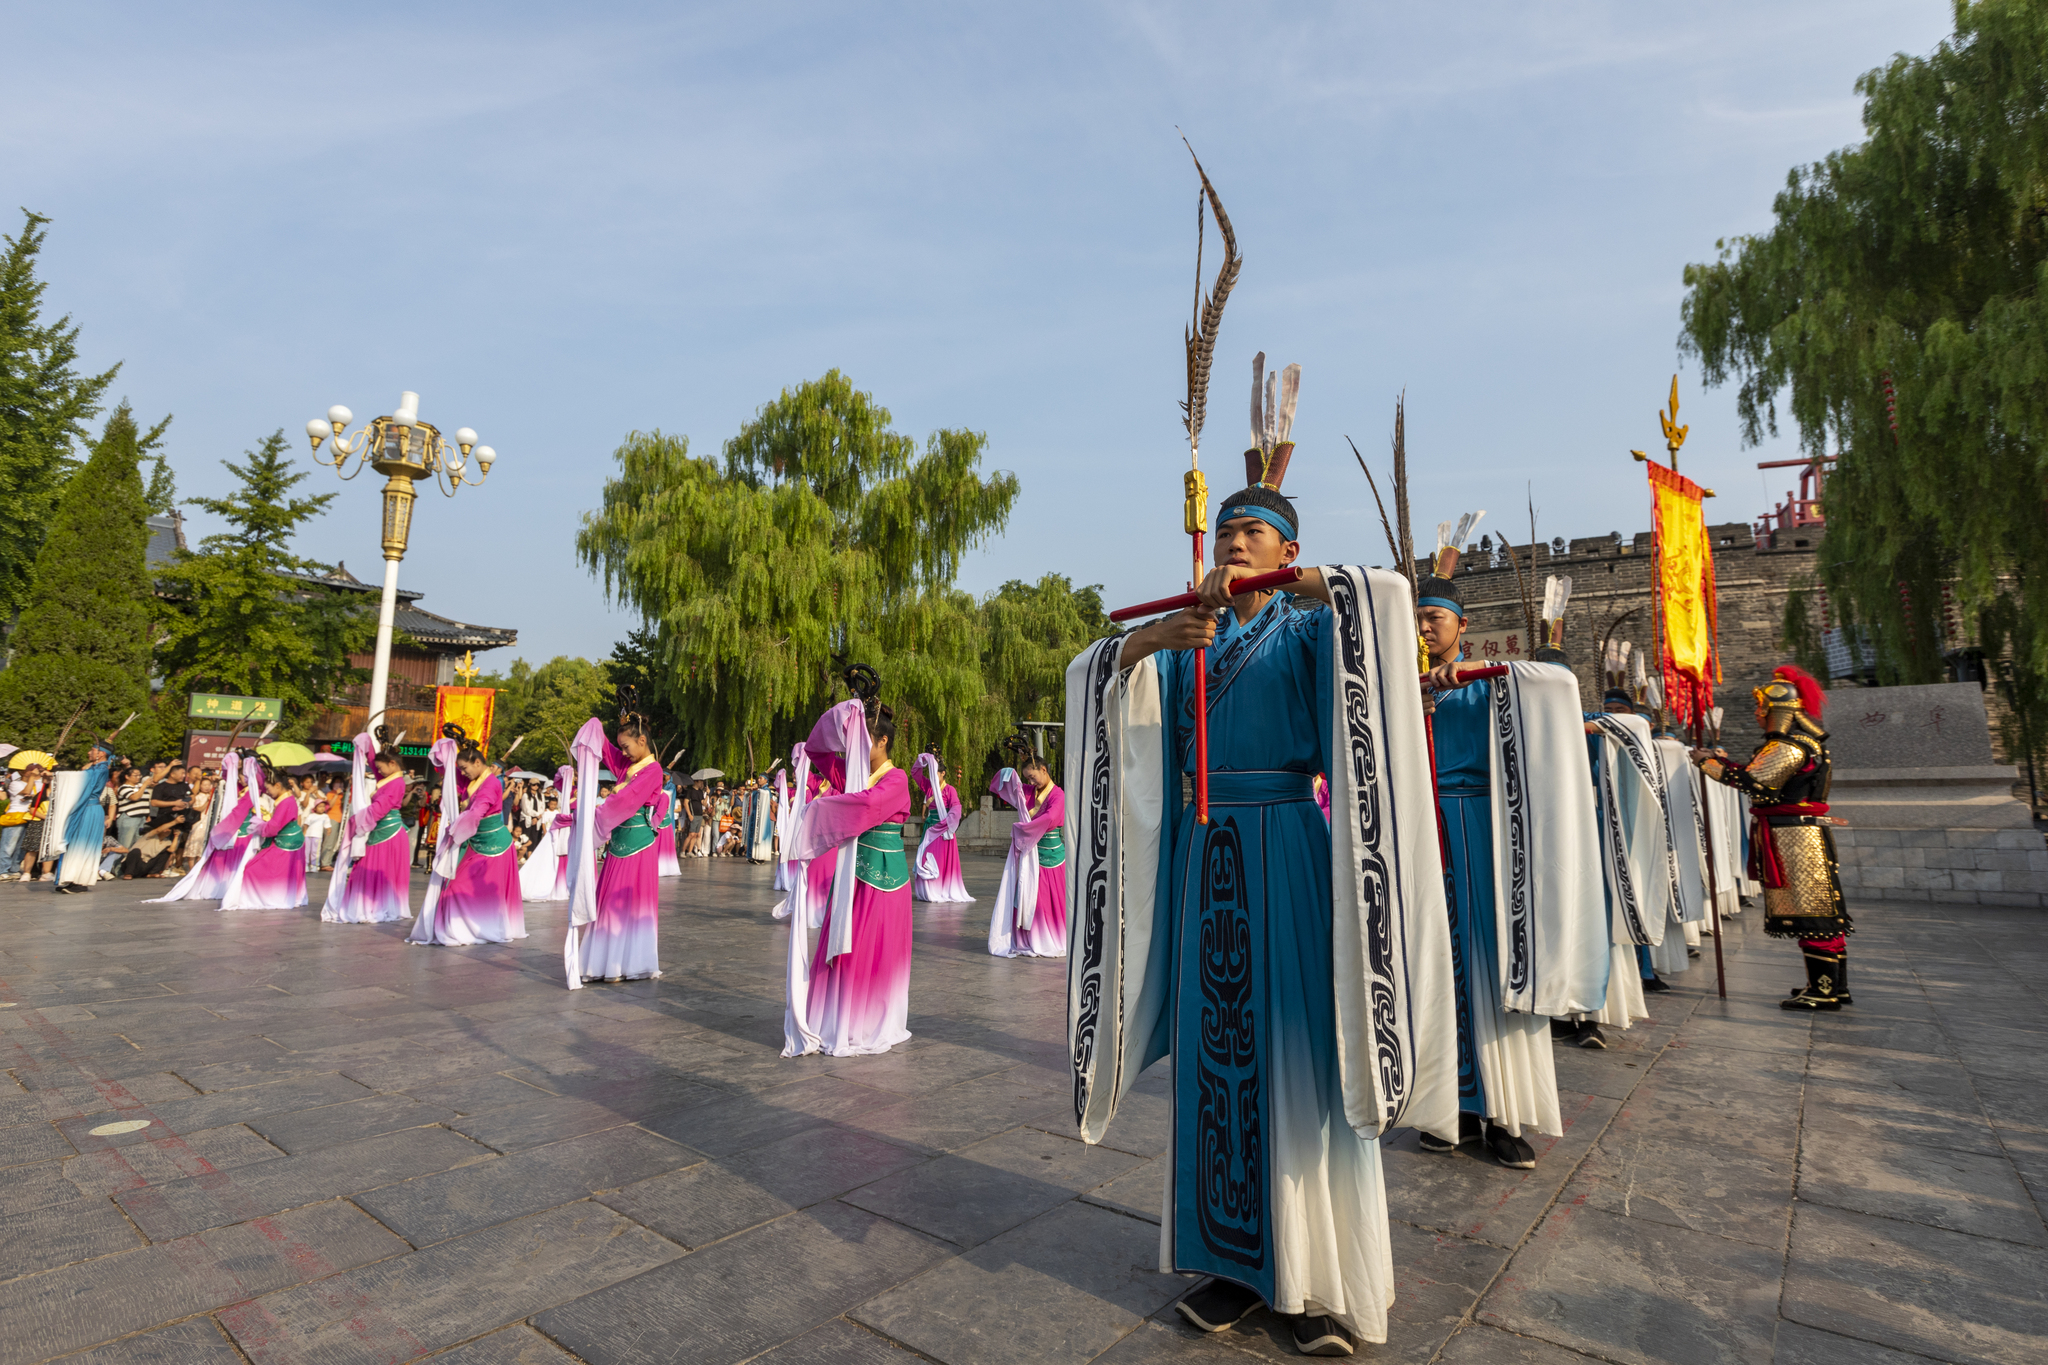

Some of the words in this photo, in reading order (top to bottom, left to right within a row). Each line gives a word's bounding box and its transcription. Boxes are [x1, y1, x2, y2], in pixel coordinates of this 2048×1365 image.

[206, 698, 266, 712] 神道路
[1859, 704, 1946, 734] 曲阜
